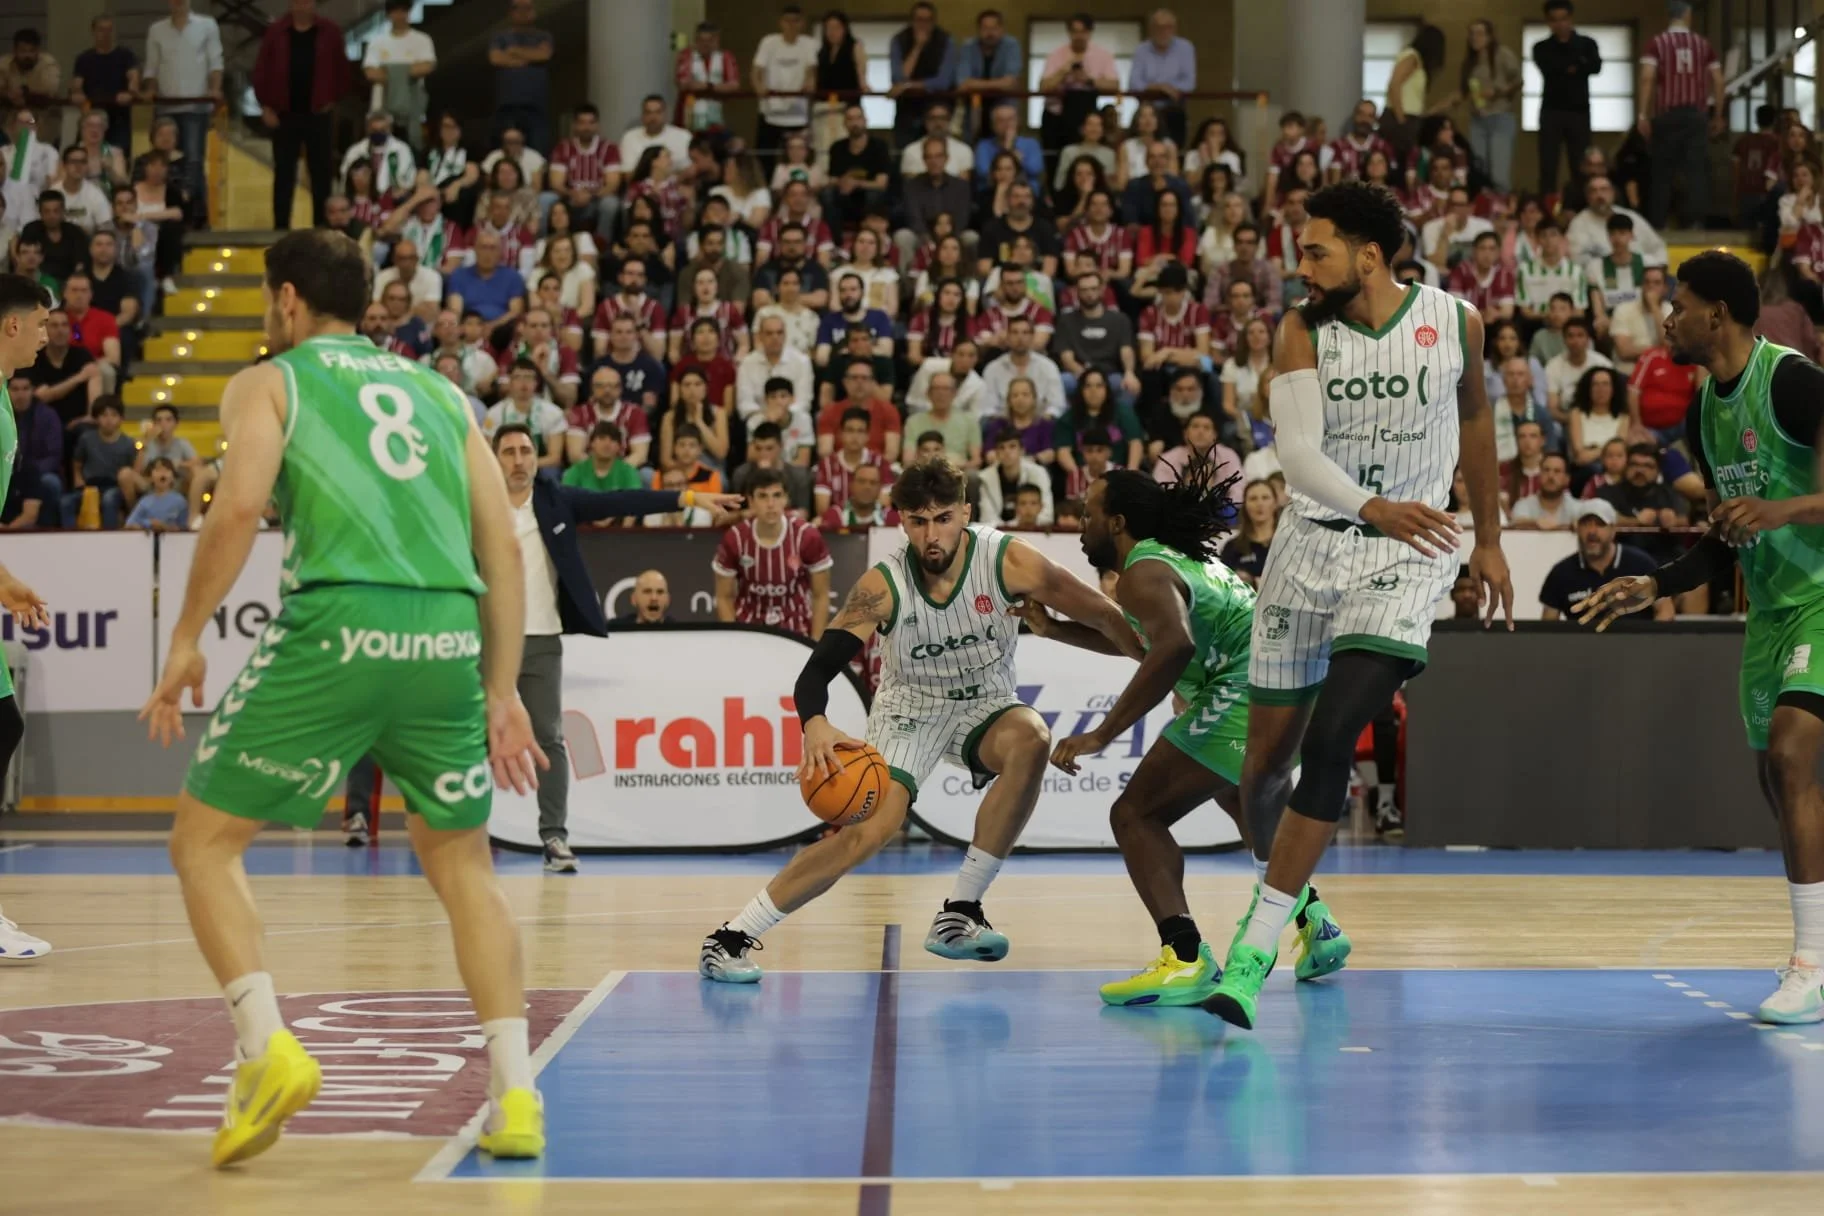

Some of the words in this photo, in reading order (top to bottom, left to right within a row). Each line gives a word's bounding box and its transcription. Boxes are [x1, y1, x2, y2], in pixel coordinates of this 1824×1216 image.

[1326, 371, 1409, 402] coto
[358, 383, 428, 480] 8
[1380, 426, 1427, 446] Cajasol
[910, 635, 979, 660] coto
[614, 773, 720, 788] INSTALACIONES
[727, 769, 800, 786] ELÉCTRICA
[1080, 771, 1111, 792] de
